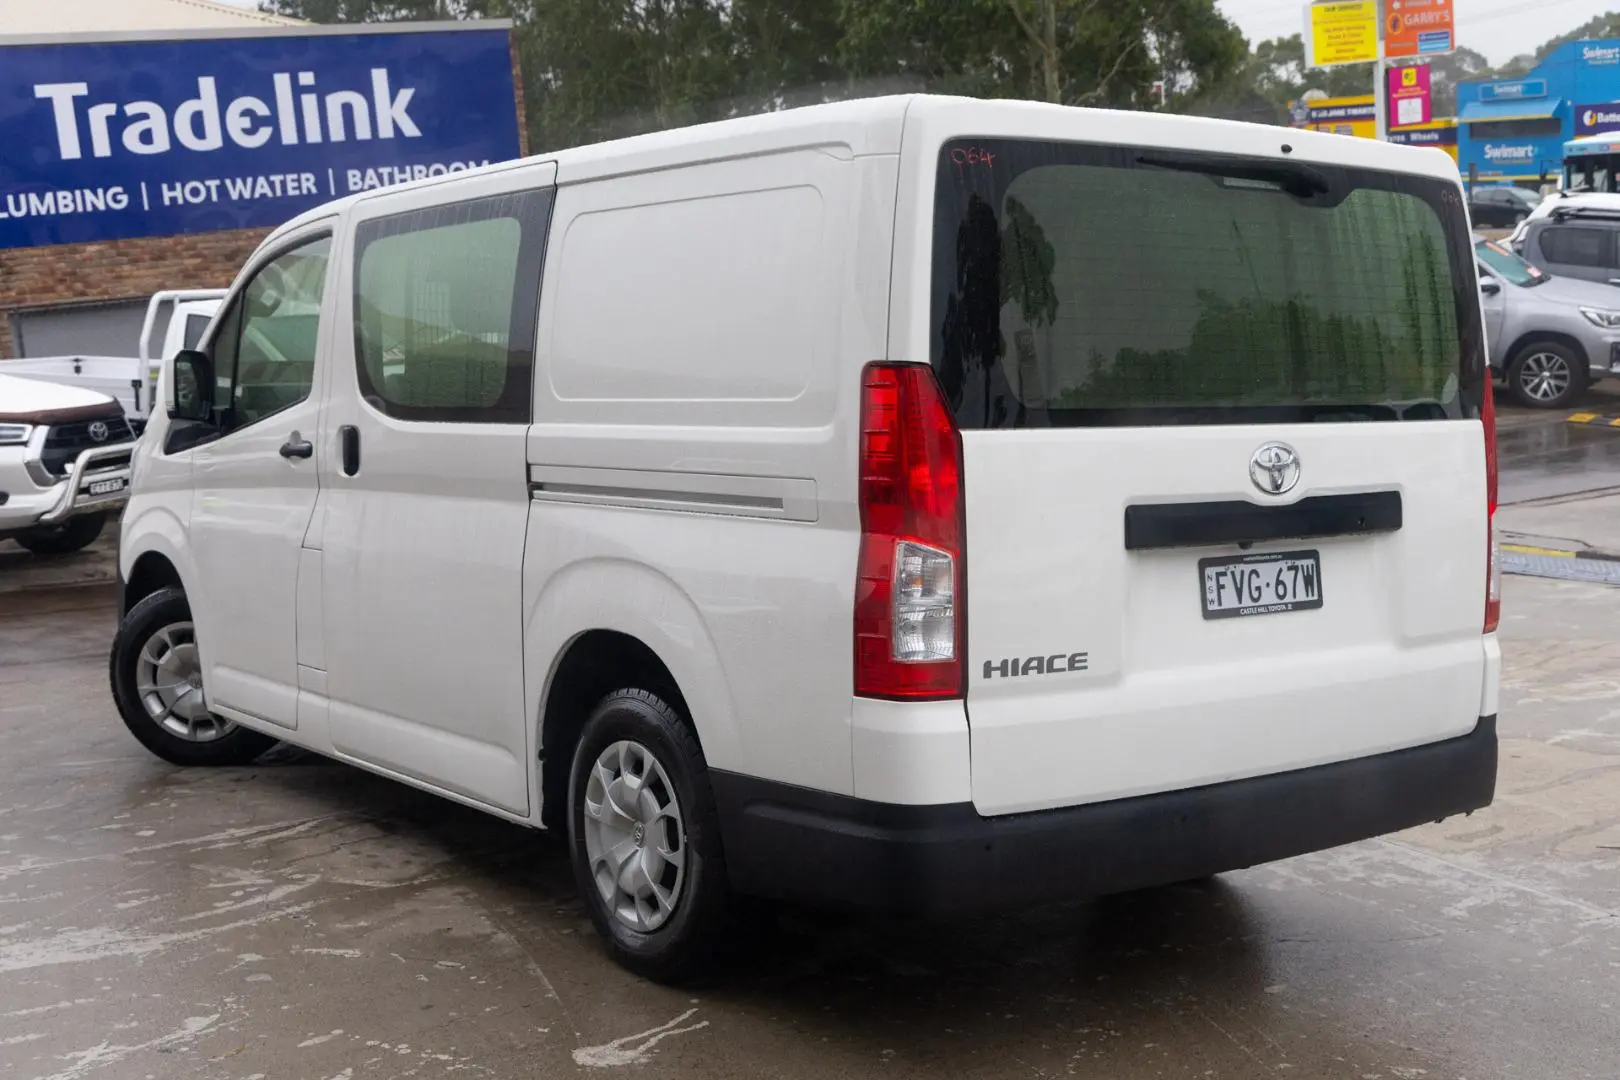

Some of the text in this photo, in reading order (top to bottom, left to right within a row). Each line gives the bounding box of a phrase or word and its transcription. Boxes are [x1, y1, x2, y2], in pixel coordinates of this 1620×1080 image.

[33, 68, 422, 160] Tradelink
[161, 180, 221, 206] HOT
[224, 172, 318, 200] WATER
[347, 160, 490, 191] BATHRO
[983, 652, 1088, 679] HIACE
